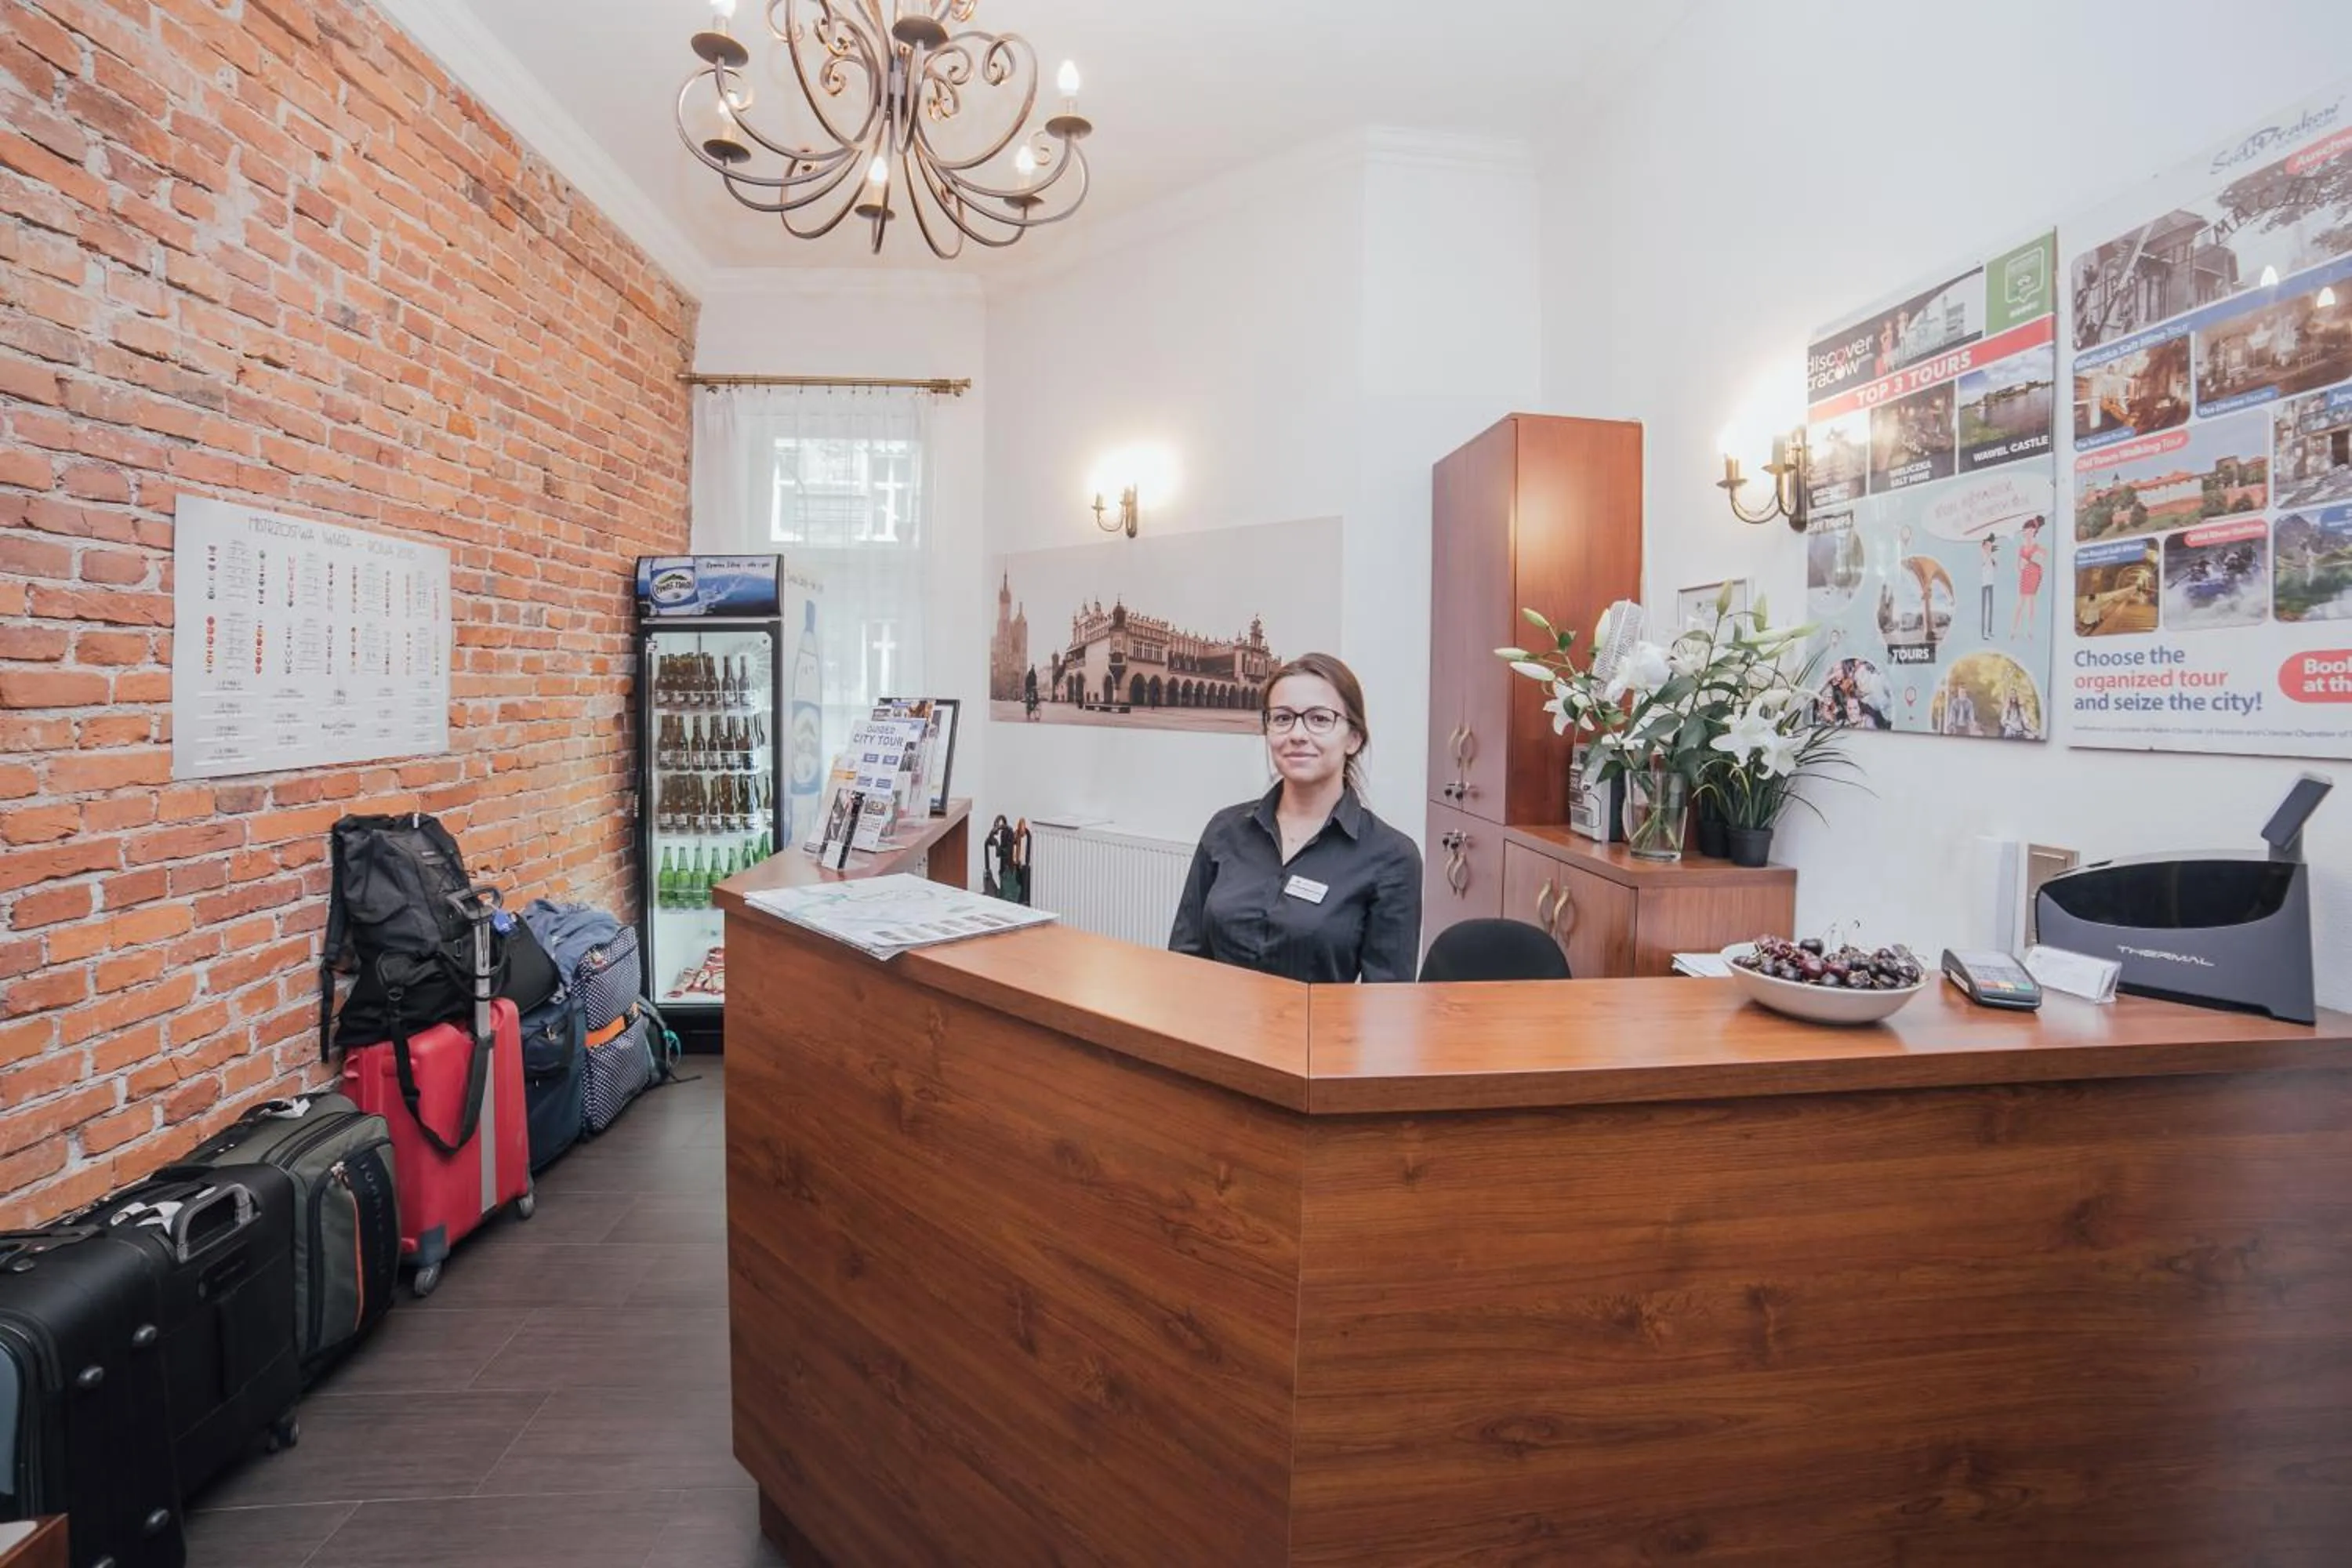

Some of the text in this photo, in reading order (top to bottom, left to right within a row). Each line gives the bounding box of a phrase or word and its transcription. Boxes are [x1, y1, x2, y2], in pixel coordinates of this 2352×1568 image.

[1857, 350, 1973, 406] TOP 3 TOURS
[2009, 434, 2049, 453] CASTLE
[1892, 648, 1929, 661] TOURS
[2074, 645, 2185, 667] Choose the
[2074, 670, 2228, 692] organized tour
[2303, 677, 2325, 691] at
[2074, 691, 2263, 717] and seize the city!
[853, 733, 876, 745] CITY
[2118, 945, 2216, 967] THERMAL
